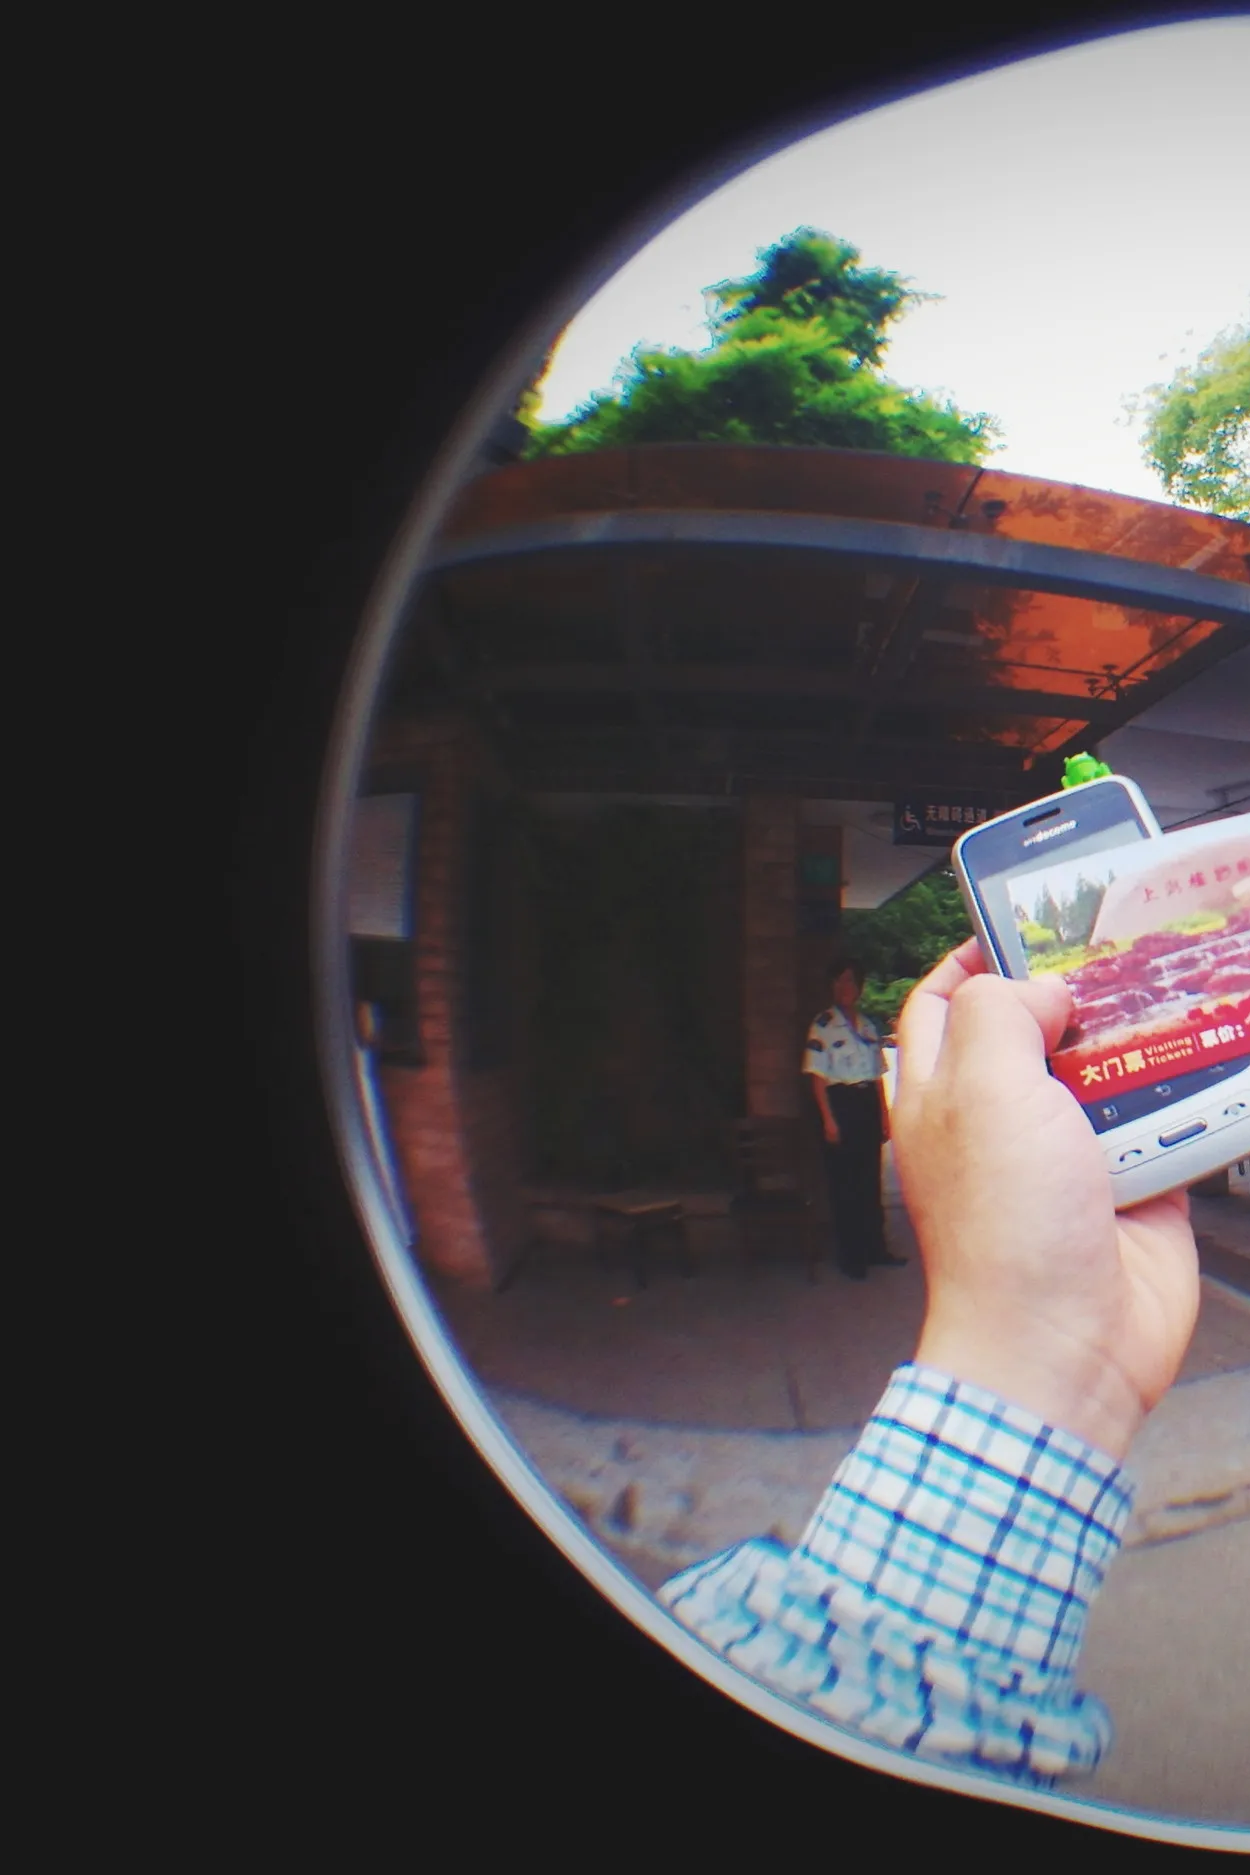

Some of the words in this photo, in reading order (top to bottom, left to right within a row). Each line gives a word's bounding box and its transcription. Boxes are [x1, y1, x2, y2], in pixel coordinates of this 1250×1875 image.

[1144, 1035, 1193, 1056] Visiting
[1147, 1047, 1194, 1067] Tickets
[1079, 1049, 1146, 1087] 大门票
